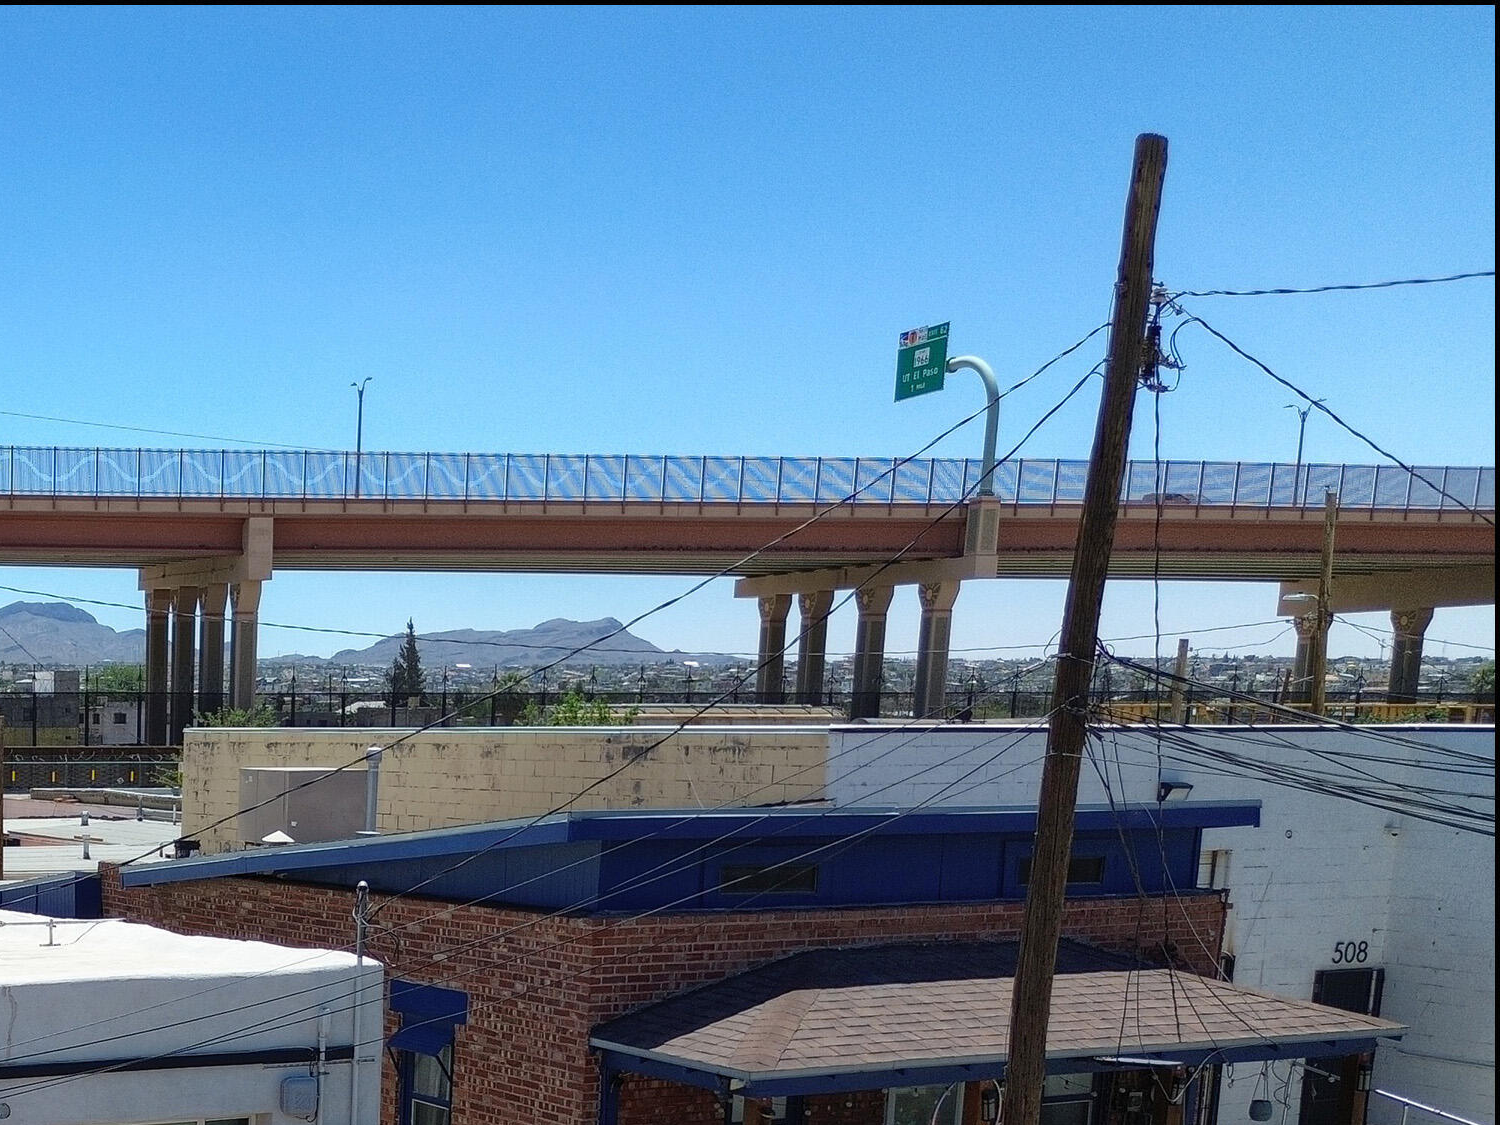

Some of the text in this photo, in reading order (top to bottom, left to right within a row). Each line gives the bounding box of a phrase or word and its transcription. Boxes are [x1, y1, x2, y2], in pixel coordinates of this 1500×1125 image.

[902, 367, 938, 383] UT El Paso
[1331, 940, 1368, 964] 508
